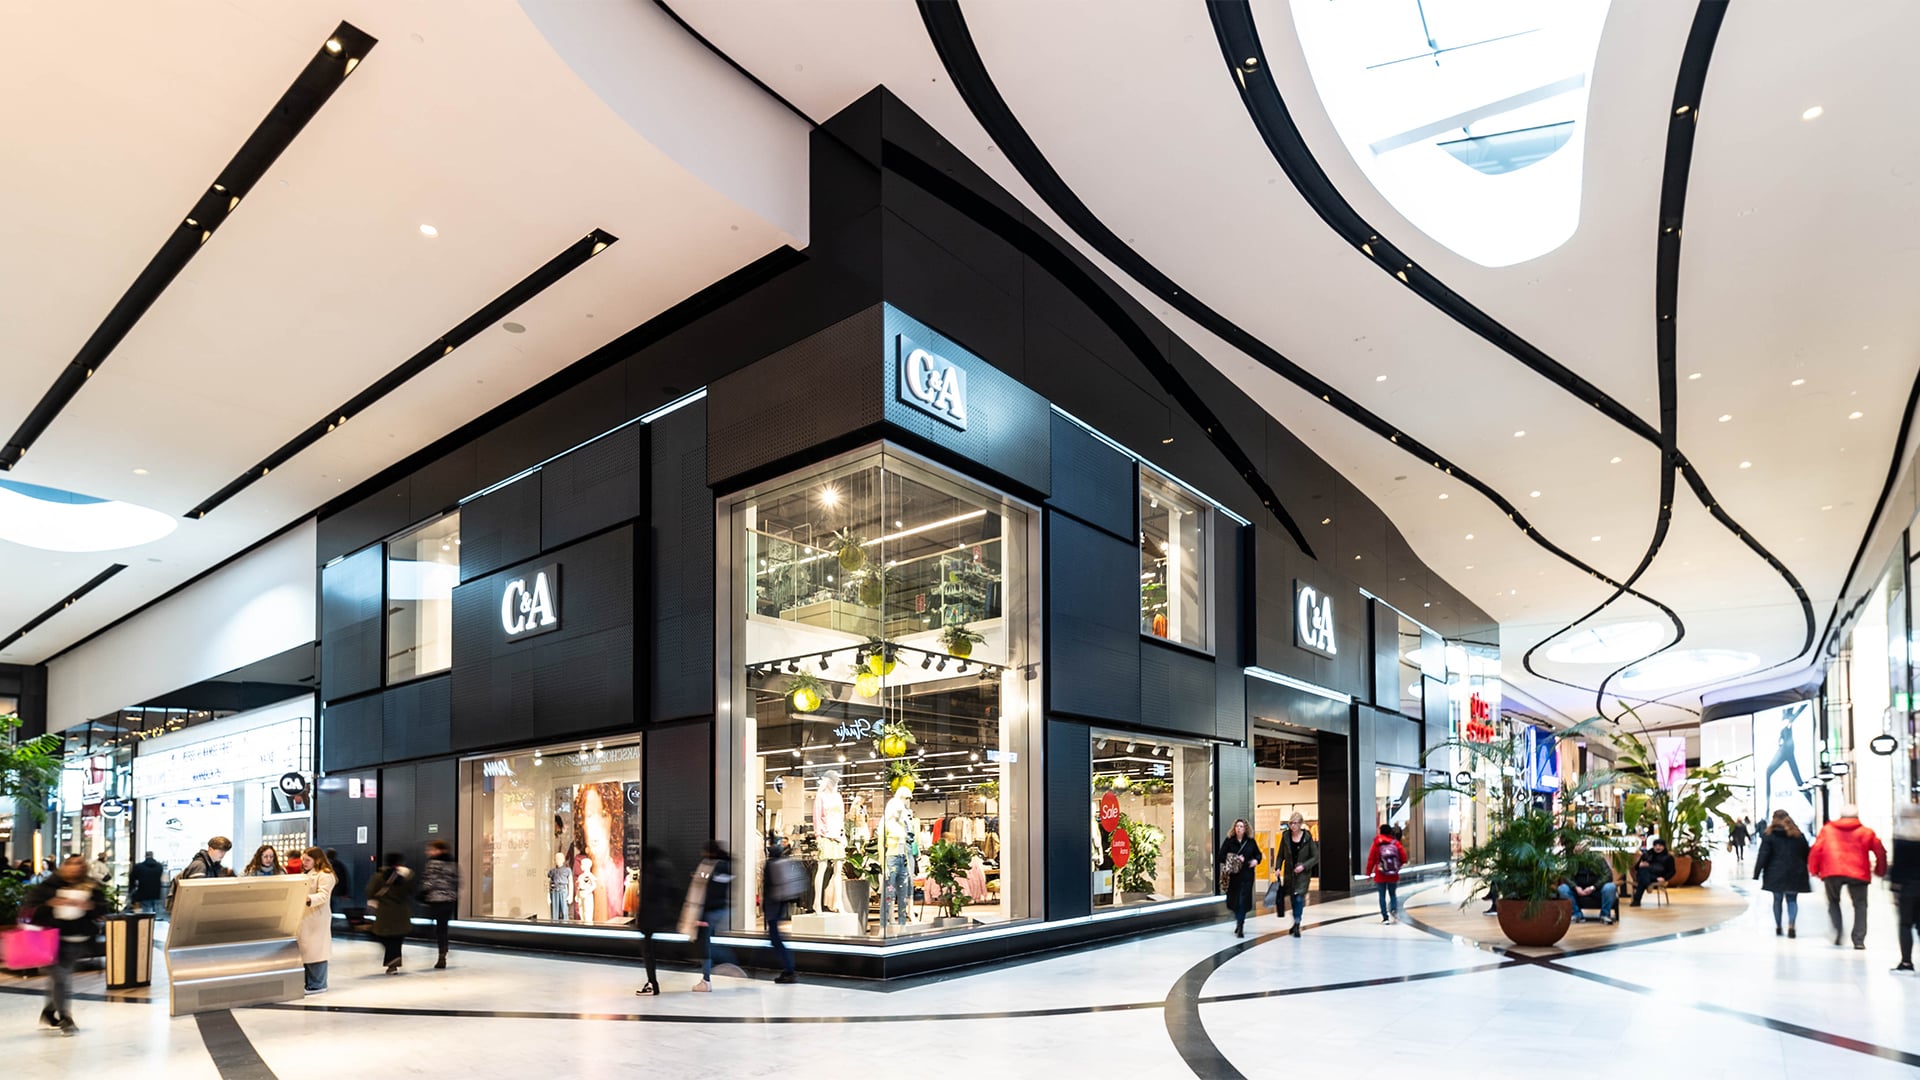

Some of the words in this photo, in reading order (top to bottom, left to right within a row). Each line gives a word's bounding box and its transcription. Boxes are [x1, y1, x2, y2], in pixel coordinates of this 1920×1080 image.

[905, 348, 966, 420] C&A
[502, 571, 557, 635] C&A
[1299, 586, 1337, 655] C&A
[1102, 803, 1118, 820] Sale
